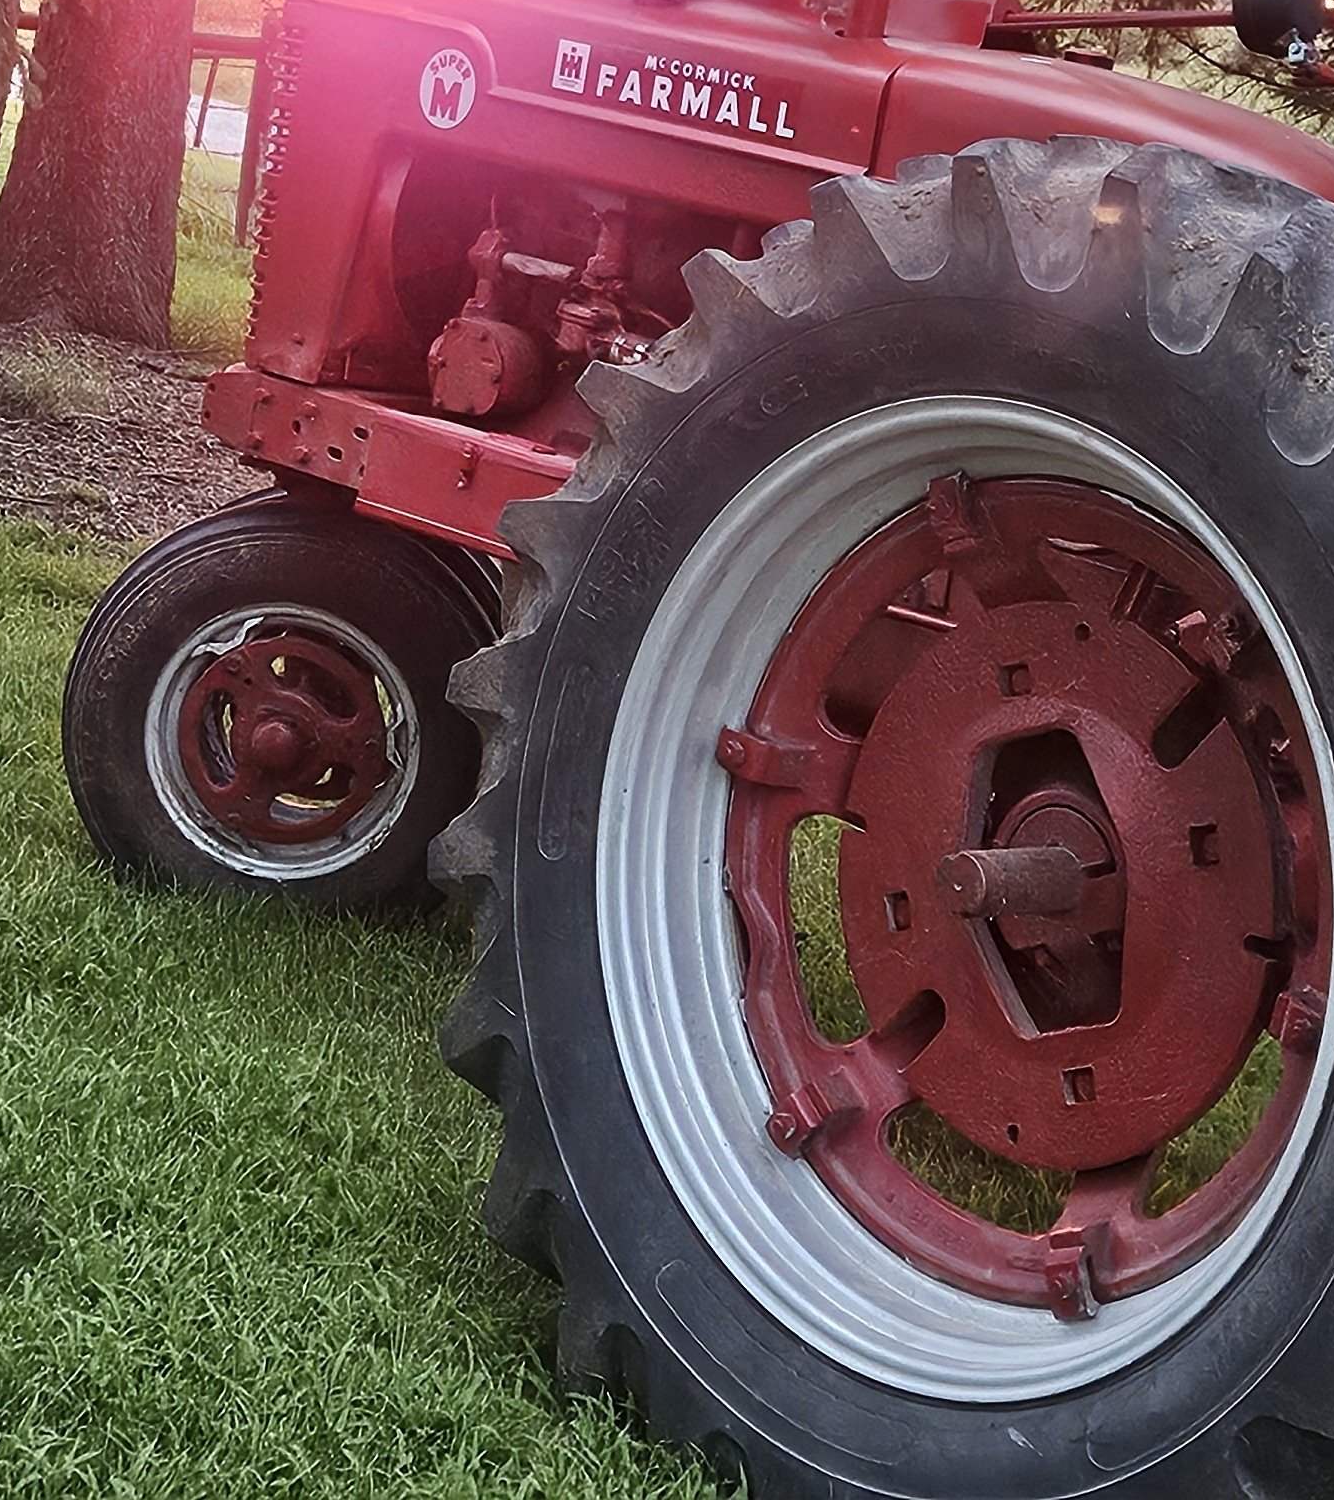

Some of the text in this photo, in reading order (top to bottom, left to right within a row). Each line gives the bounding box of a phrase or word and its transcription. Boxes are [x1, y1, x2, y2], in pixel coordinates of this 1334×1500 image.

[429, 54, 472, 81] SUPER
[429, 77, 463, 122] M
[596, 63, 795, 139] FARMALL
